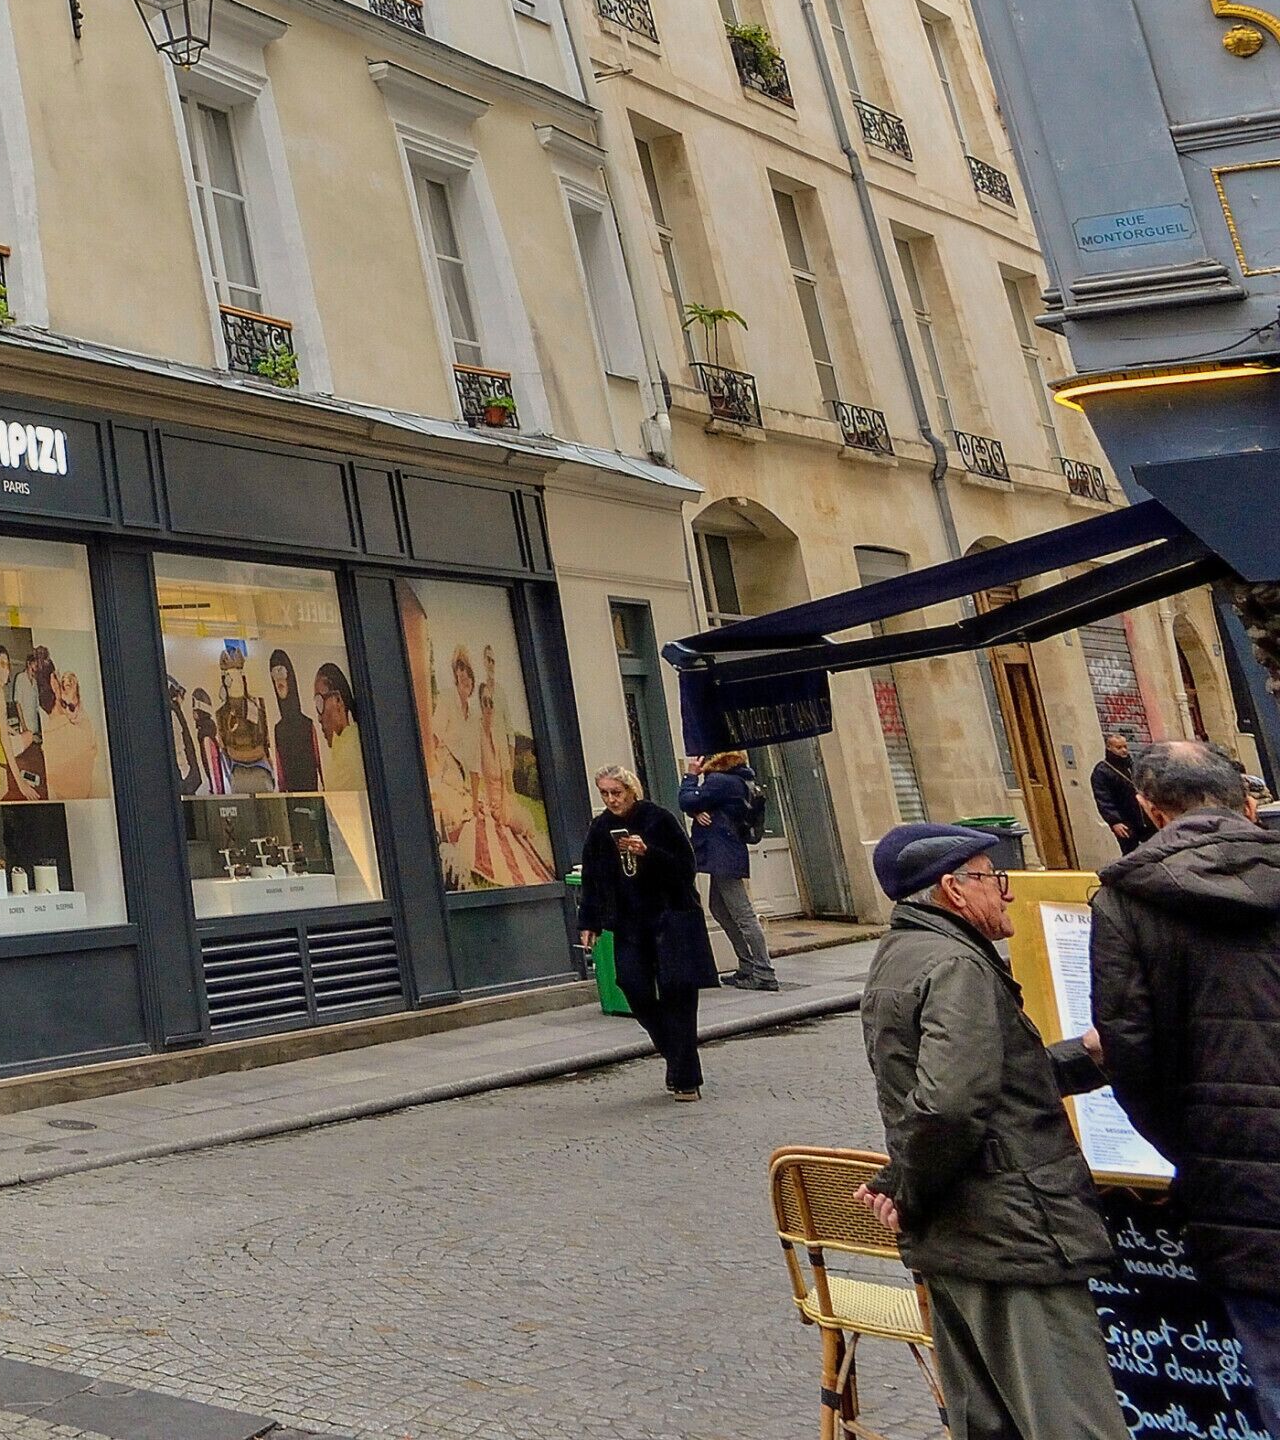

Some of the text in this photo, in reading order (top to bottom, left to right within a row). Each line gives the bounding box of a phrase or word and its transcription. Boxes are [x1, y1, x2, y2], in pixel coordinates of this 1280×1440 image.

[1116, 214, 1146, 228] RUE
[1081, 223, 1189, 247] MONTORGUEIL
[3, 480, 31, 495] PARIS
[1053, 912, 1075, 923] AU
